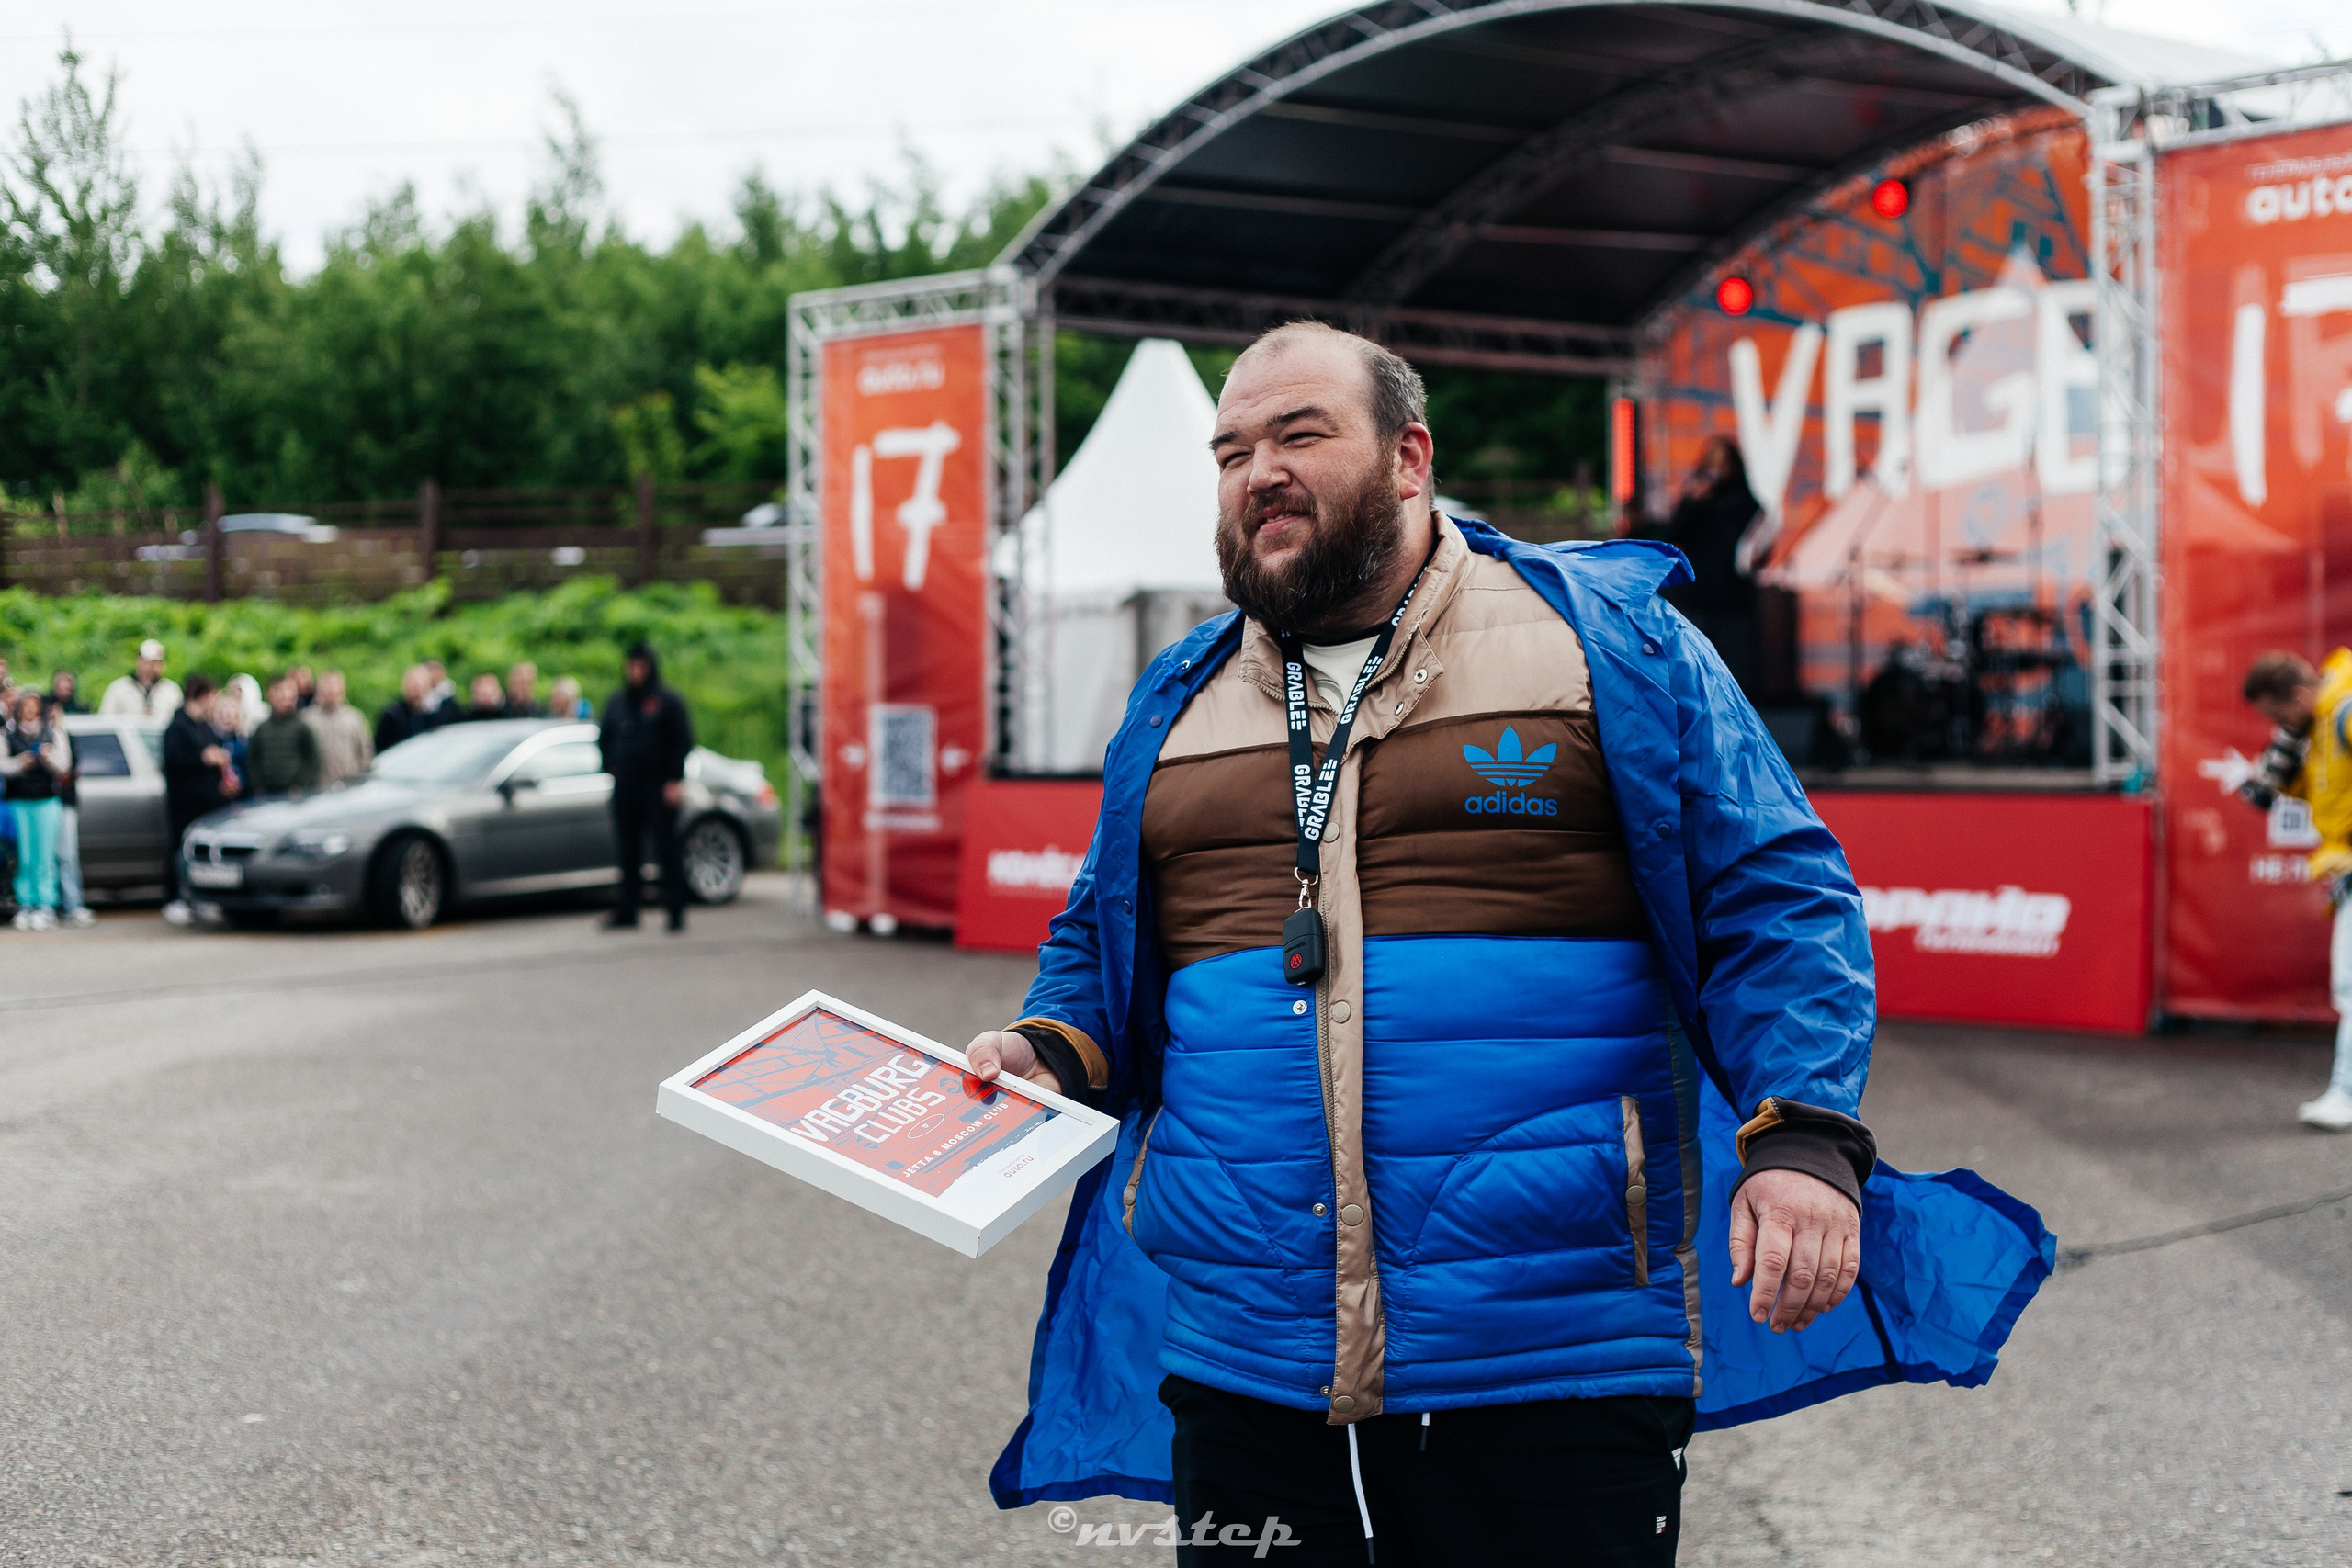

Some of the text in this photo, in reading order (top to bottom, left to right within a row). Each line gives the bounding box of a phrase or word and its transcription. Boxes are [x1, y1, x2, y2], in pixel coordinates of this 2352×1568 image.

[850, 420, 961, 592] 17
[1464, 790, 1558, 817] adidas
[790, 1054, 933, 1142] VAGBURG
[854, 1086, 947, 1144] CLUBS
[902, 1155, 934, 1178] JETTA
[941, 1120, 983, 1150] MOSCOW
[983, 1102, 1010, 1121] CLUB
[1003, 1156, 1035, 1178] auto.ru
